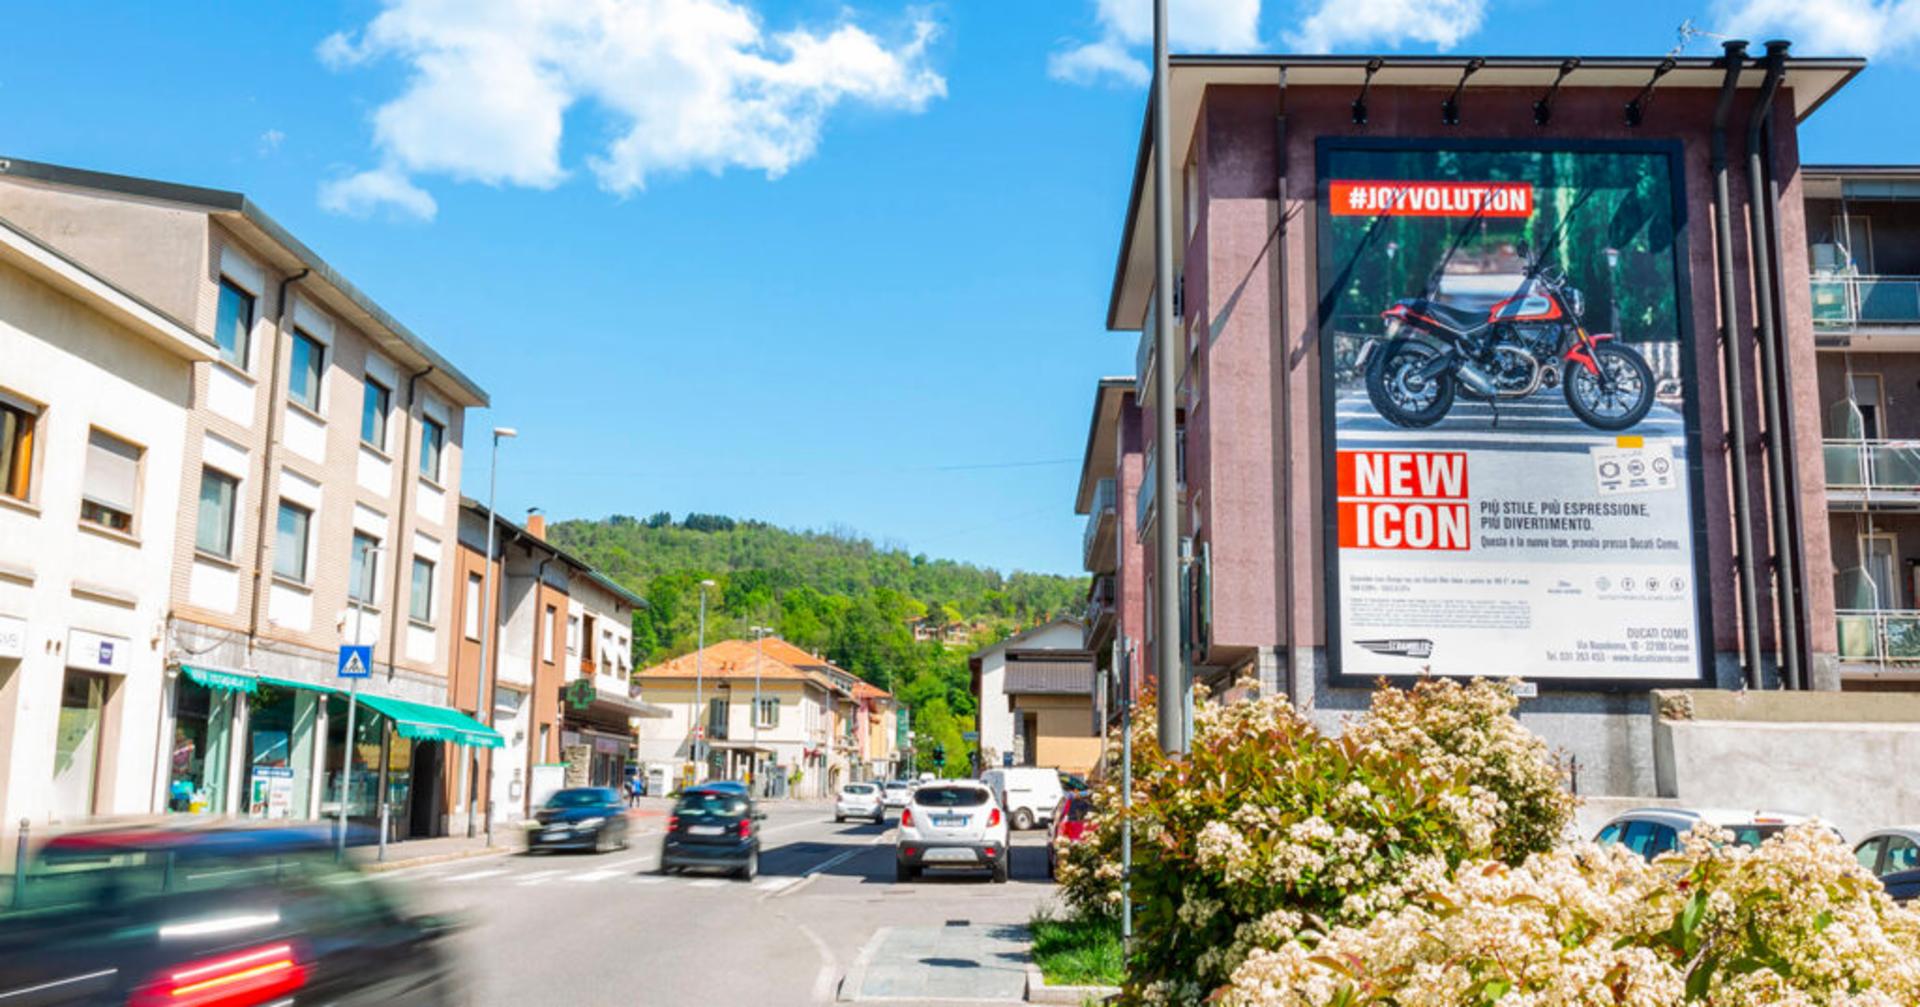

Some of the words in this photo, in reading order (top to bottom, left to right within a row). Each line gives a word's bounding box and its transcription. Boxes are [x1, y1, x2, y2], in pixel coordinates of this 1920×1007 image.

[1349, 187, 1526, 211] #JOYVOLUTION
[1355, 453, 1464, 496] NEW
[1480, 500, 1500, 516] PIÙ
[1503, 502, 1538, 516] STILE,
[1540, 499, 1561, 515] PIÙ
[1564, 502, 1651, 517] ESPRESSIONE,
[1356, 504, 1468, 549] ICON
[1480, 515, 1501, 530] PIÙ
[1503, 517, 1594, 531] DIVERTIMENTO.
[1480, 535, 1507, 548] Questa
[1517, 536, 1524, 547] la
[1526, 537, 1549, 548] nuova
[1630, 537, 1654, 549] Ducati
[1627, 627, 1659, 639] DUCATI
[1661, 628, 1689, 640] COMO
